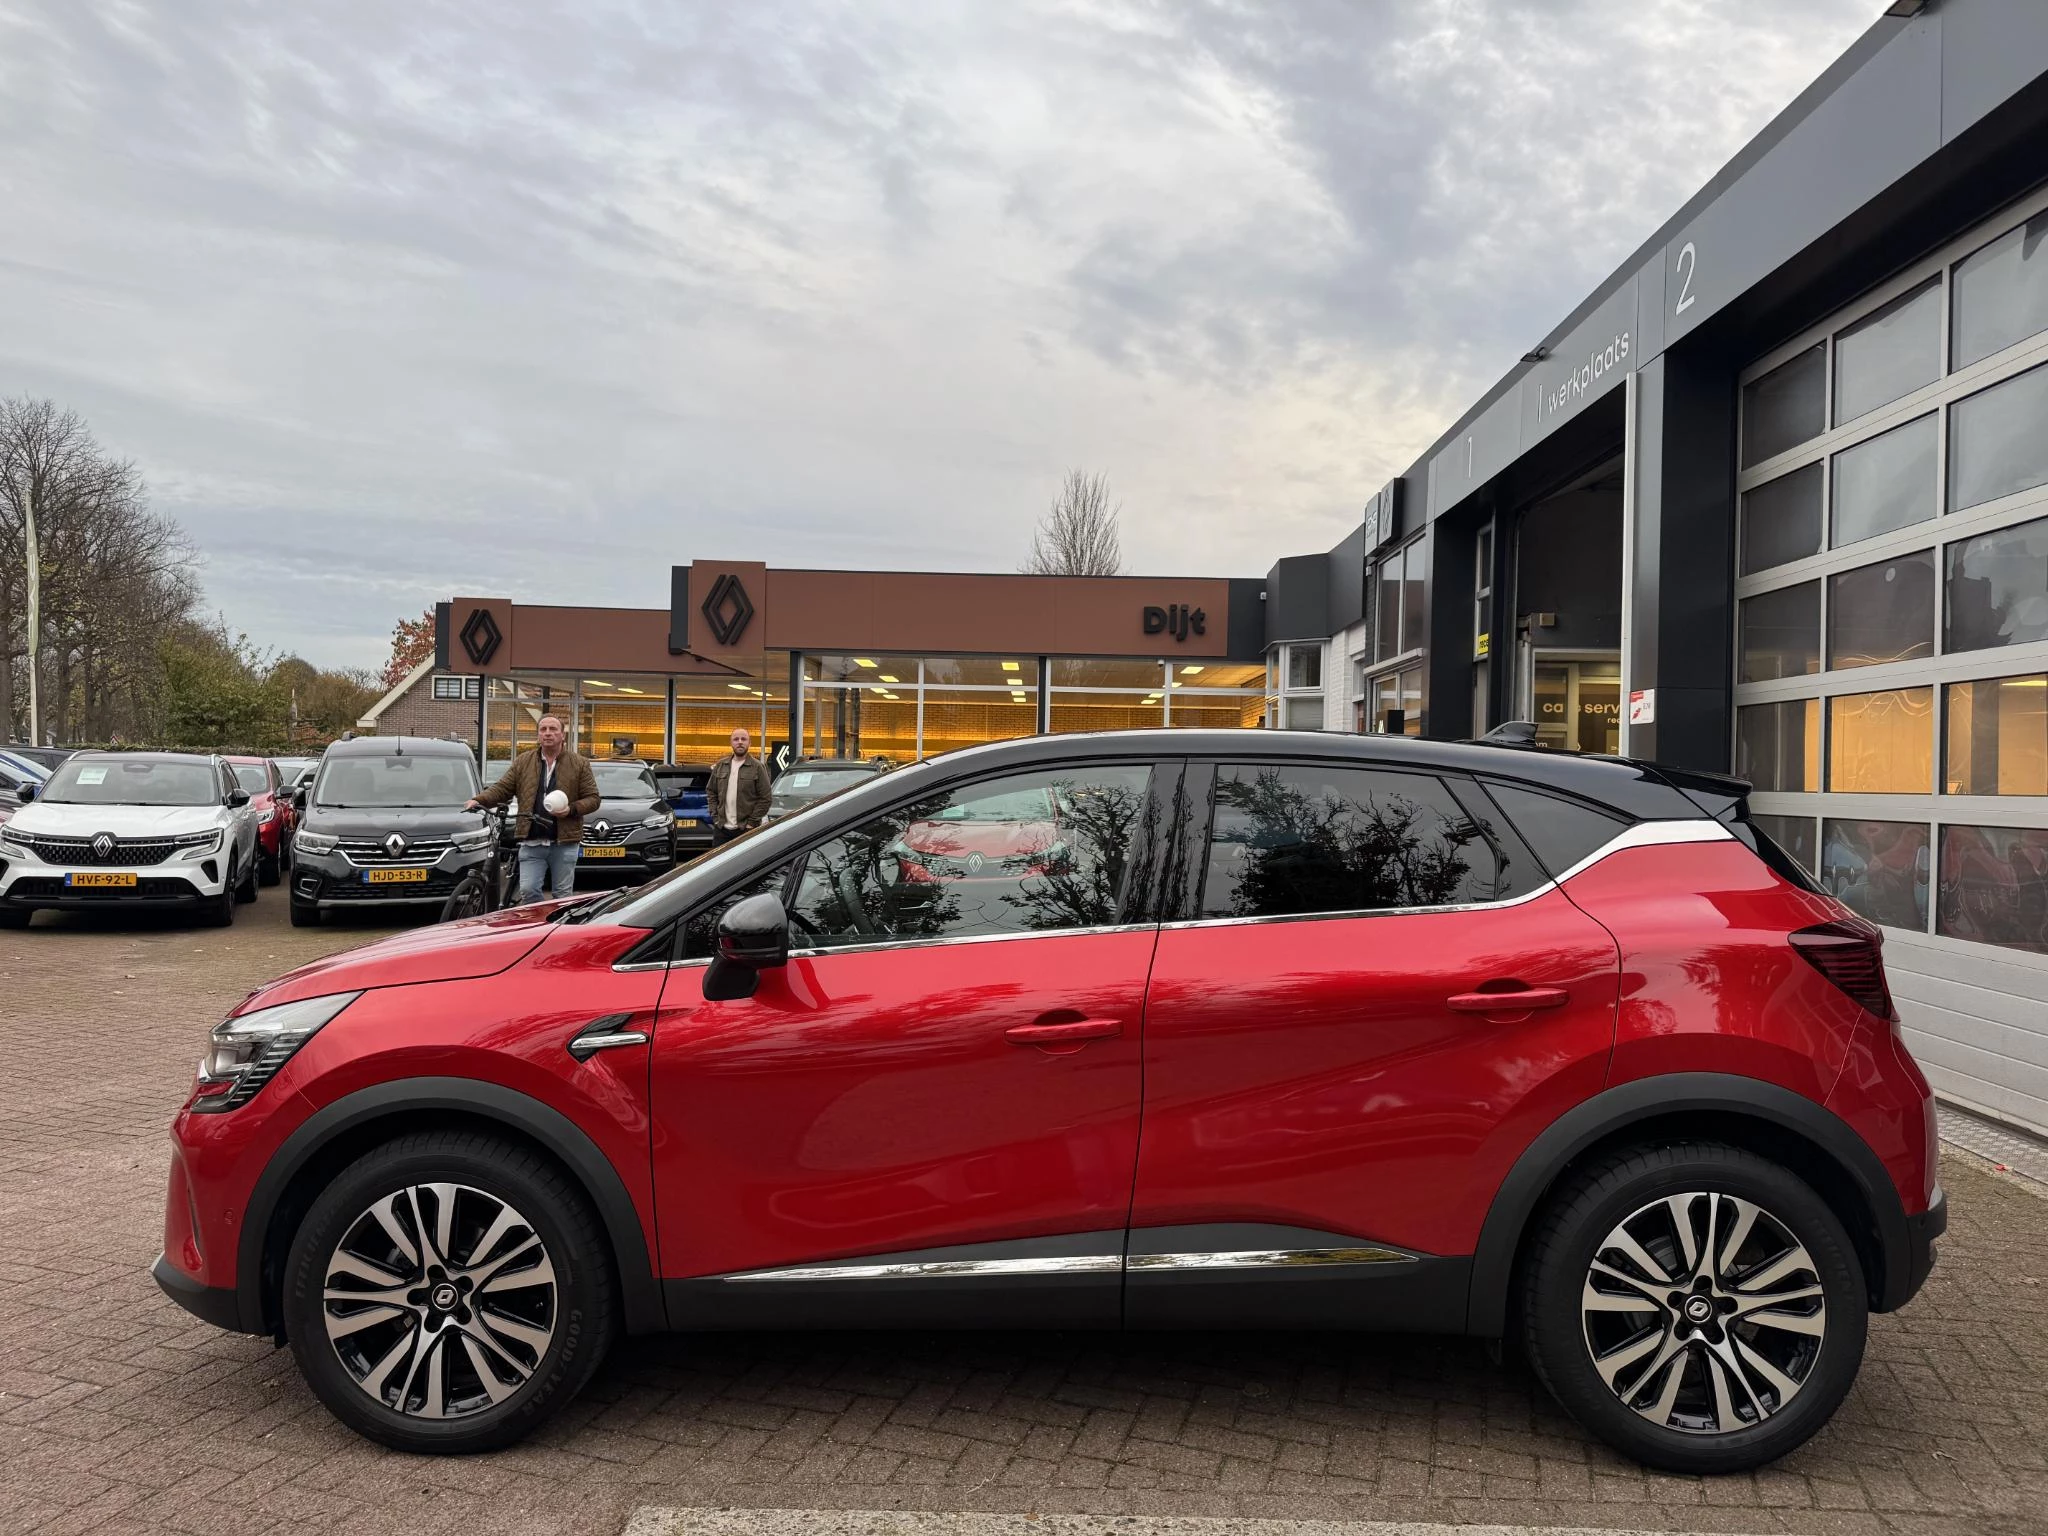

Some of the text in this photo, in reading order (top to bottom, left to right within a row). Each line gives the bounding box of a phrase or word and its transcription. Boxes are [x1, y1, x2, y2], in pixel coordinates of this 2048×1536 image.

[1676, 241, 1696, 316] 2
[1548, 332, 1629, 415] werkplaats
[1467, 436, 1473, 478] 1
[1143, 604, 1206, 643] Dijt
[77, 875, 132, 885] HVF-92-L
[373, 870, 423, 881] HJD-53-R
